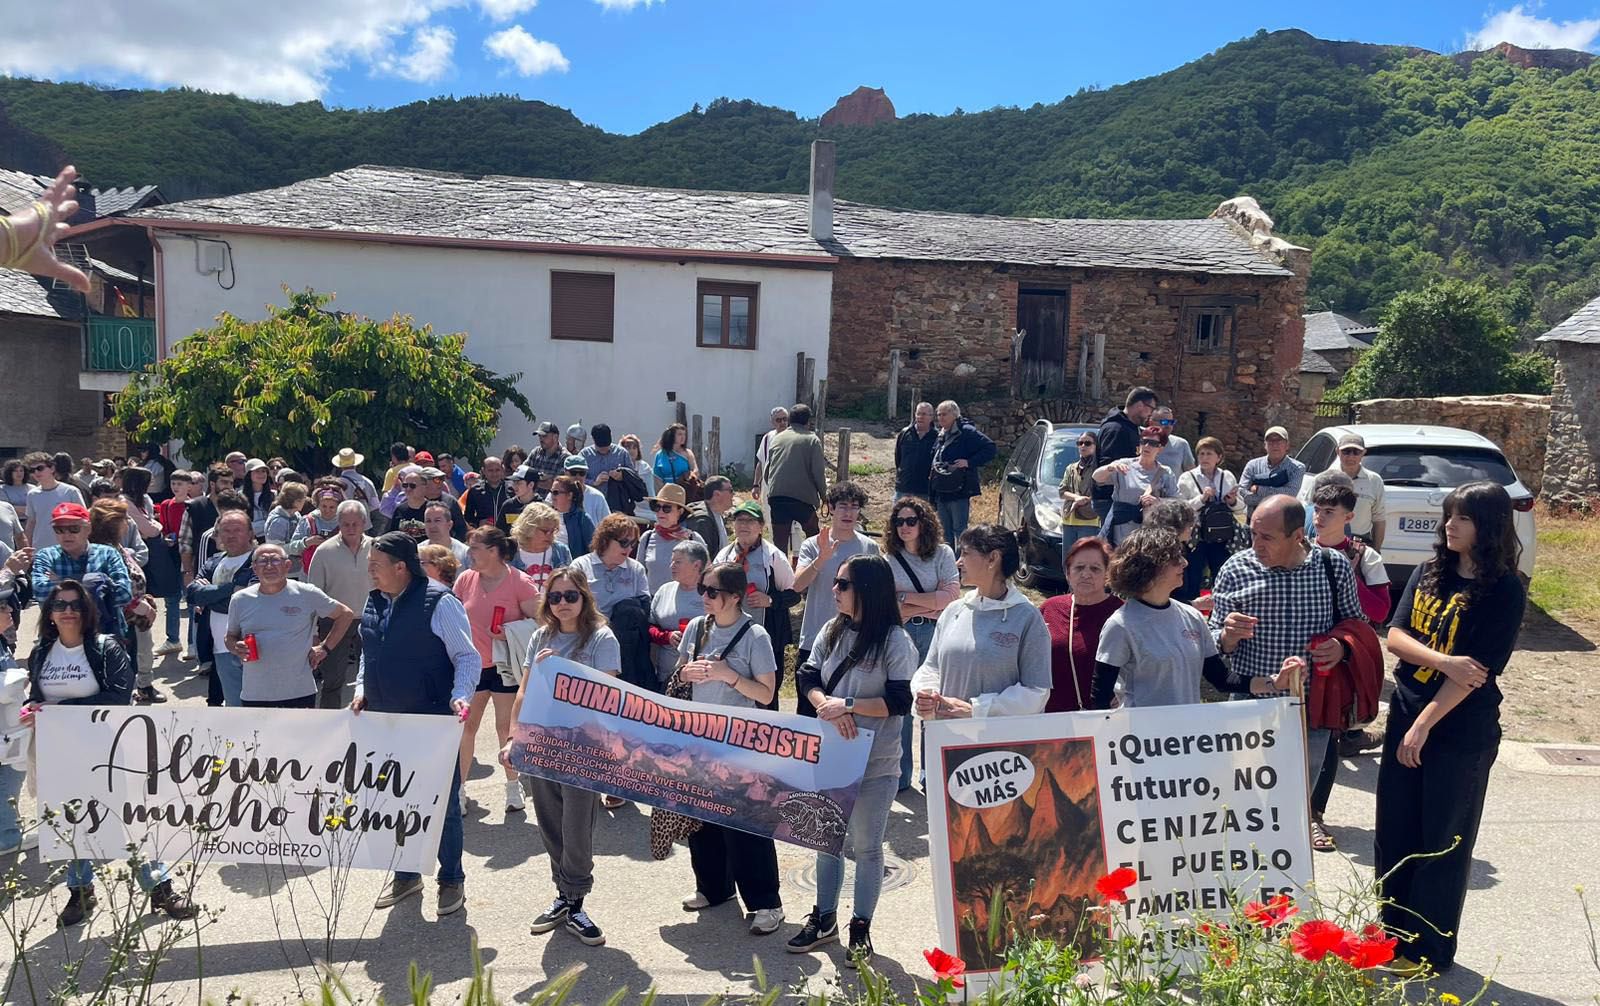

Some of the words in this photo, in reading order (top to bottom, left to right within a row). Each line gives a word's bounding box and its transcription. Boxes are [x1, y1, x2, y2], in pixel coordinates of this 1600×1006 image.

[1407, 519, 1438, 530] 2887
[554, 672, 620, 716] RUINA
[621, 692, 728, 742] MONTIUM
[728, 718, 822, 764] RESISTE
[571, 743, 583, 753] LA
[585, 746, 617, 762] TIERRA
[1108, 728, 1275, 765] ¡Queremos
[326, 742, 415, 798] día
[523, 754, 531, 763] Y
[531, 756, 578, 775] RESPETAR
[579, 768, 599, 780] SUS
[600, 773, 660, 796] TRADICIONES
[662, 790, 668, 798] Y
[526, 743, 563, 760] IMPLICA
[564, 752, 614, 772] ESCUCHAR
[615, 765, 623, 776] A
[624, 768, 653, 782] QUIEN
[655, 775, 676, 788] VIVE
[676, 781, 690, 792] EN
[691, 785, 713, 798] ELLA
[955, 755, 1027, 787] NUNCA
[1111, 774, 1221, 802] futuro,
[1234, 765, 1278, 791] NO
[64, 798, 109, 834] es
[123, 783, 295, 832] mucho
[975, 779, 1018, 806] MÁS
[1116, 807, 1281, 845] CENIZAS!
[203, 841, 322, 858] #ONCOBIERZO
[1172, 849, 1293, 877] PUEBLO
